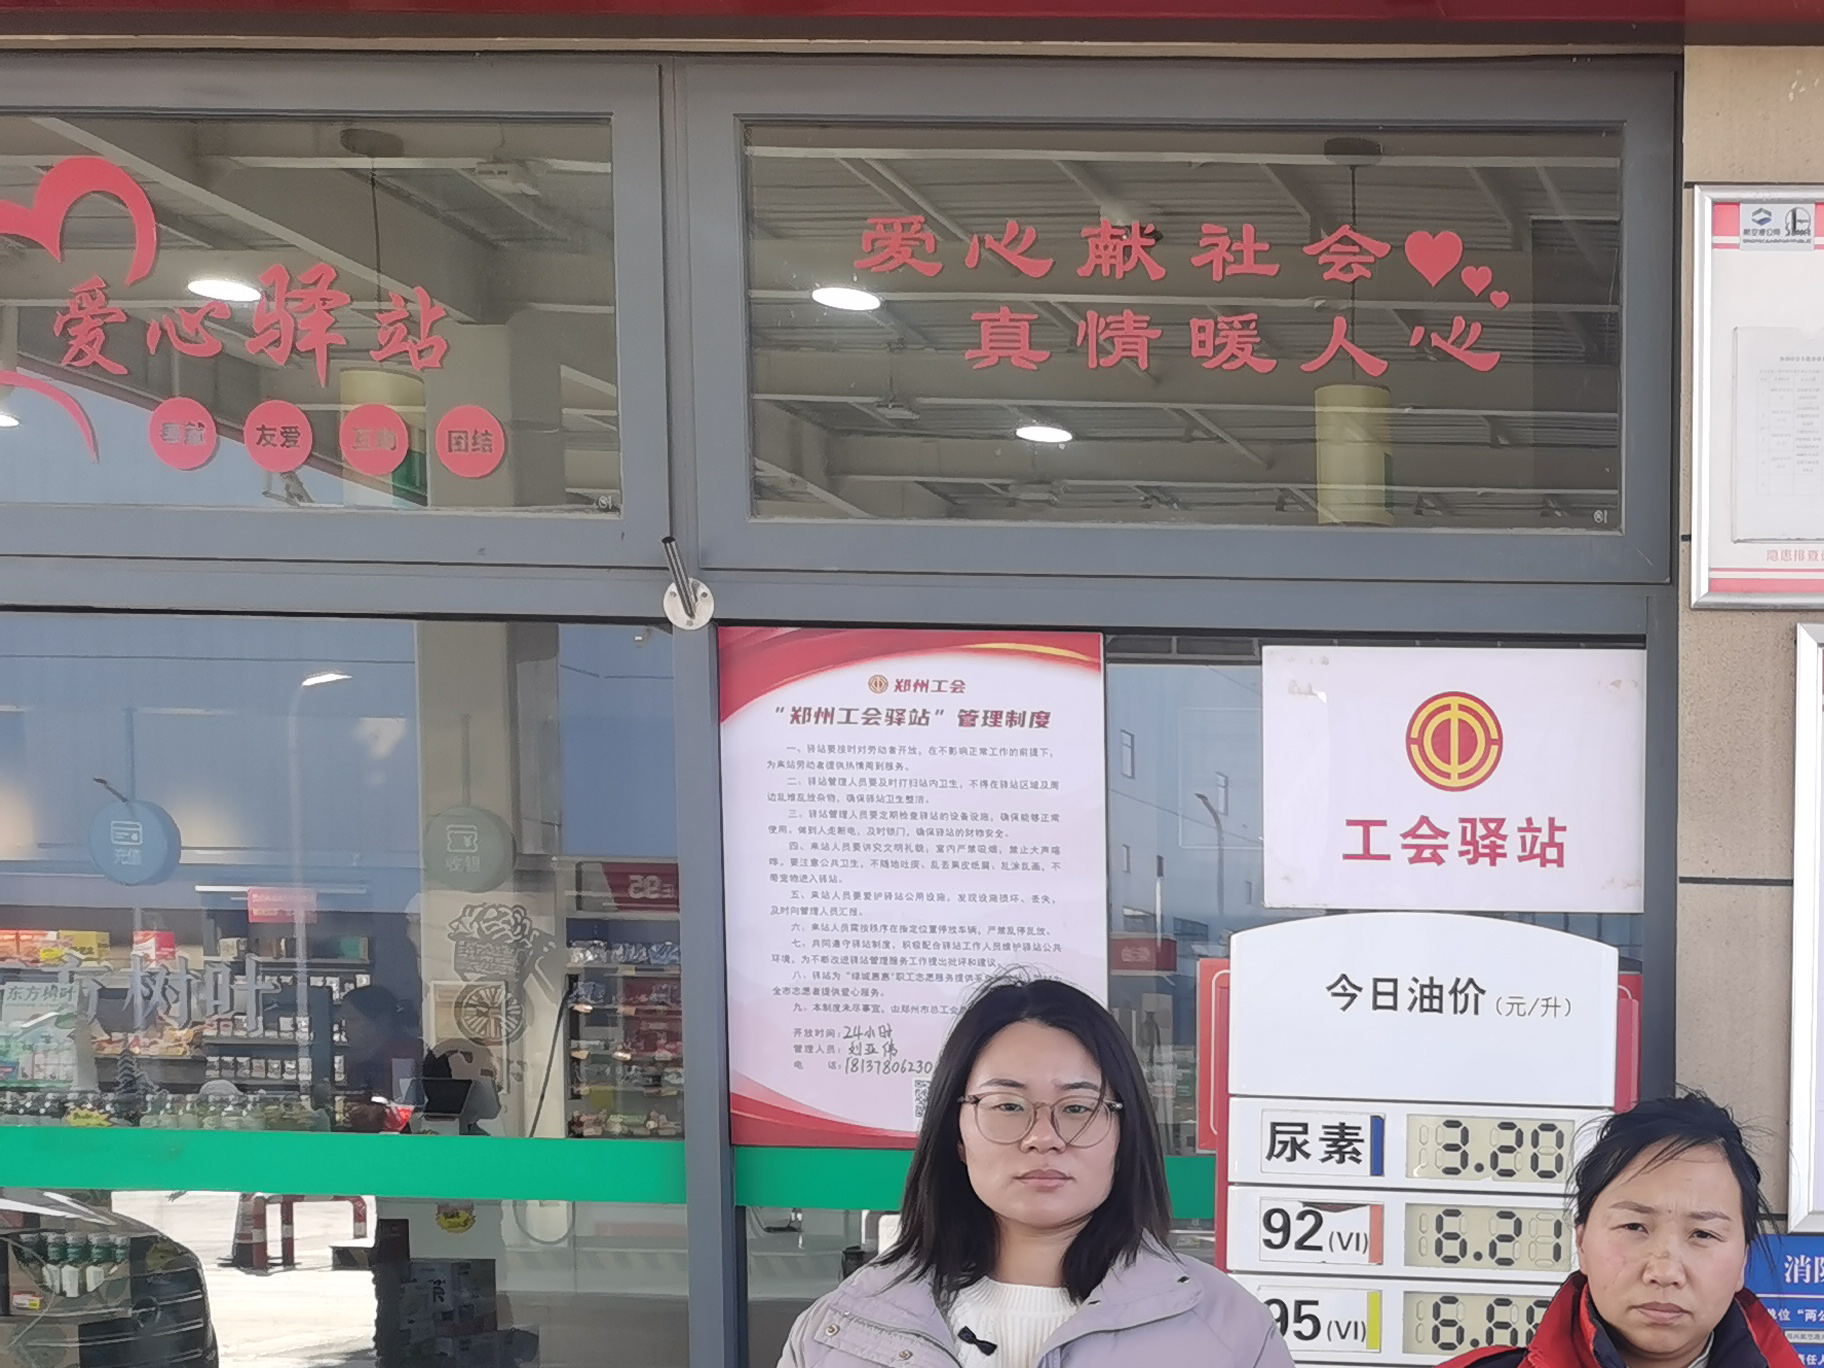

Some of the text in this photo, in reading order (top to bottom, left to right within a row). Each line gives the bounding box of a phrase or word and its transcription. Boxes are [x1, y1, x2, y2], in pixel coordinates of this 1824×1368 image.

[854, 214, 1391, 282] 爱心献社会
[54, 262, 447, 387] 爱心驿站
[964, 307, 1500, 376] 真情暖人心
[256, 424, 301, 448] 友爱
[448, 430, 494, 453] 团结
[894, 677, 967, 694] 郑州工会
[1342, 815, 1567, 868] 工会驿站
[1326, 973, 1486, 1016] 今日油价
[843, 1023, 892, 1040] 24小时
[844, 1057, 933, 1074] 18137806230
[1265, 1120, 1564, 1178] 尿素 3.20
[1262, 1207, 1325, 1251] 92
[1434, 1208, 1562, 1266] 6.21
[1264, 1298, 1321, 1341] 95
